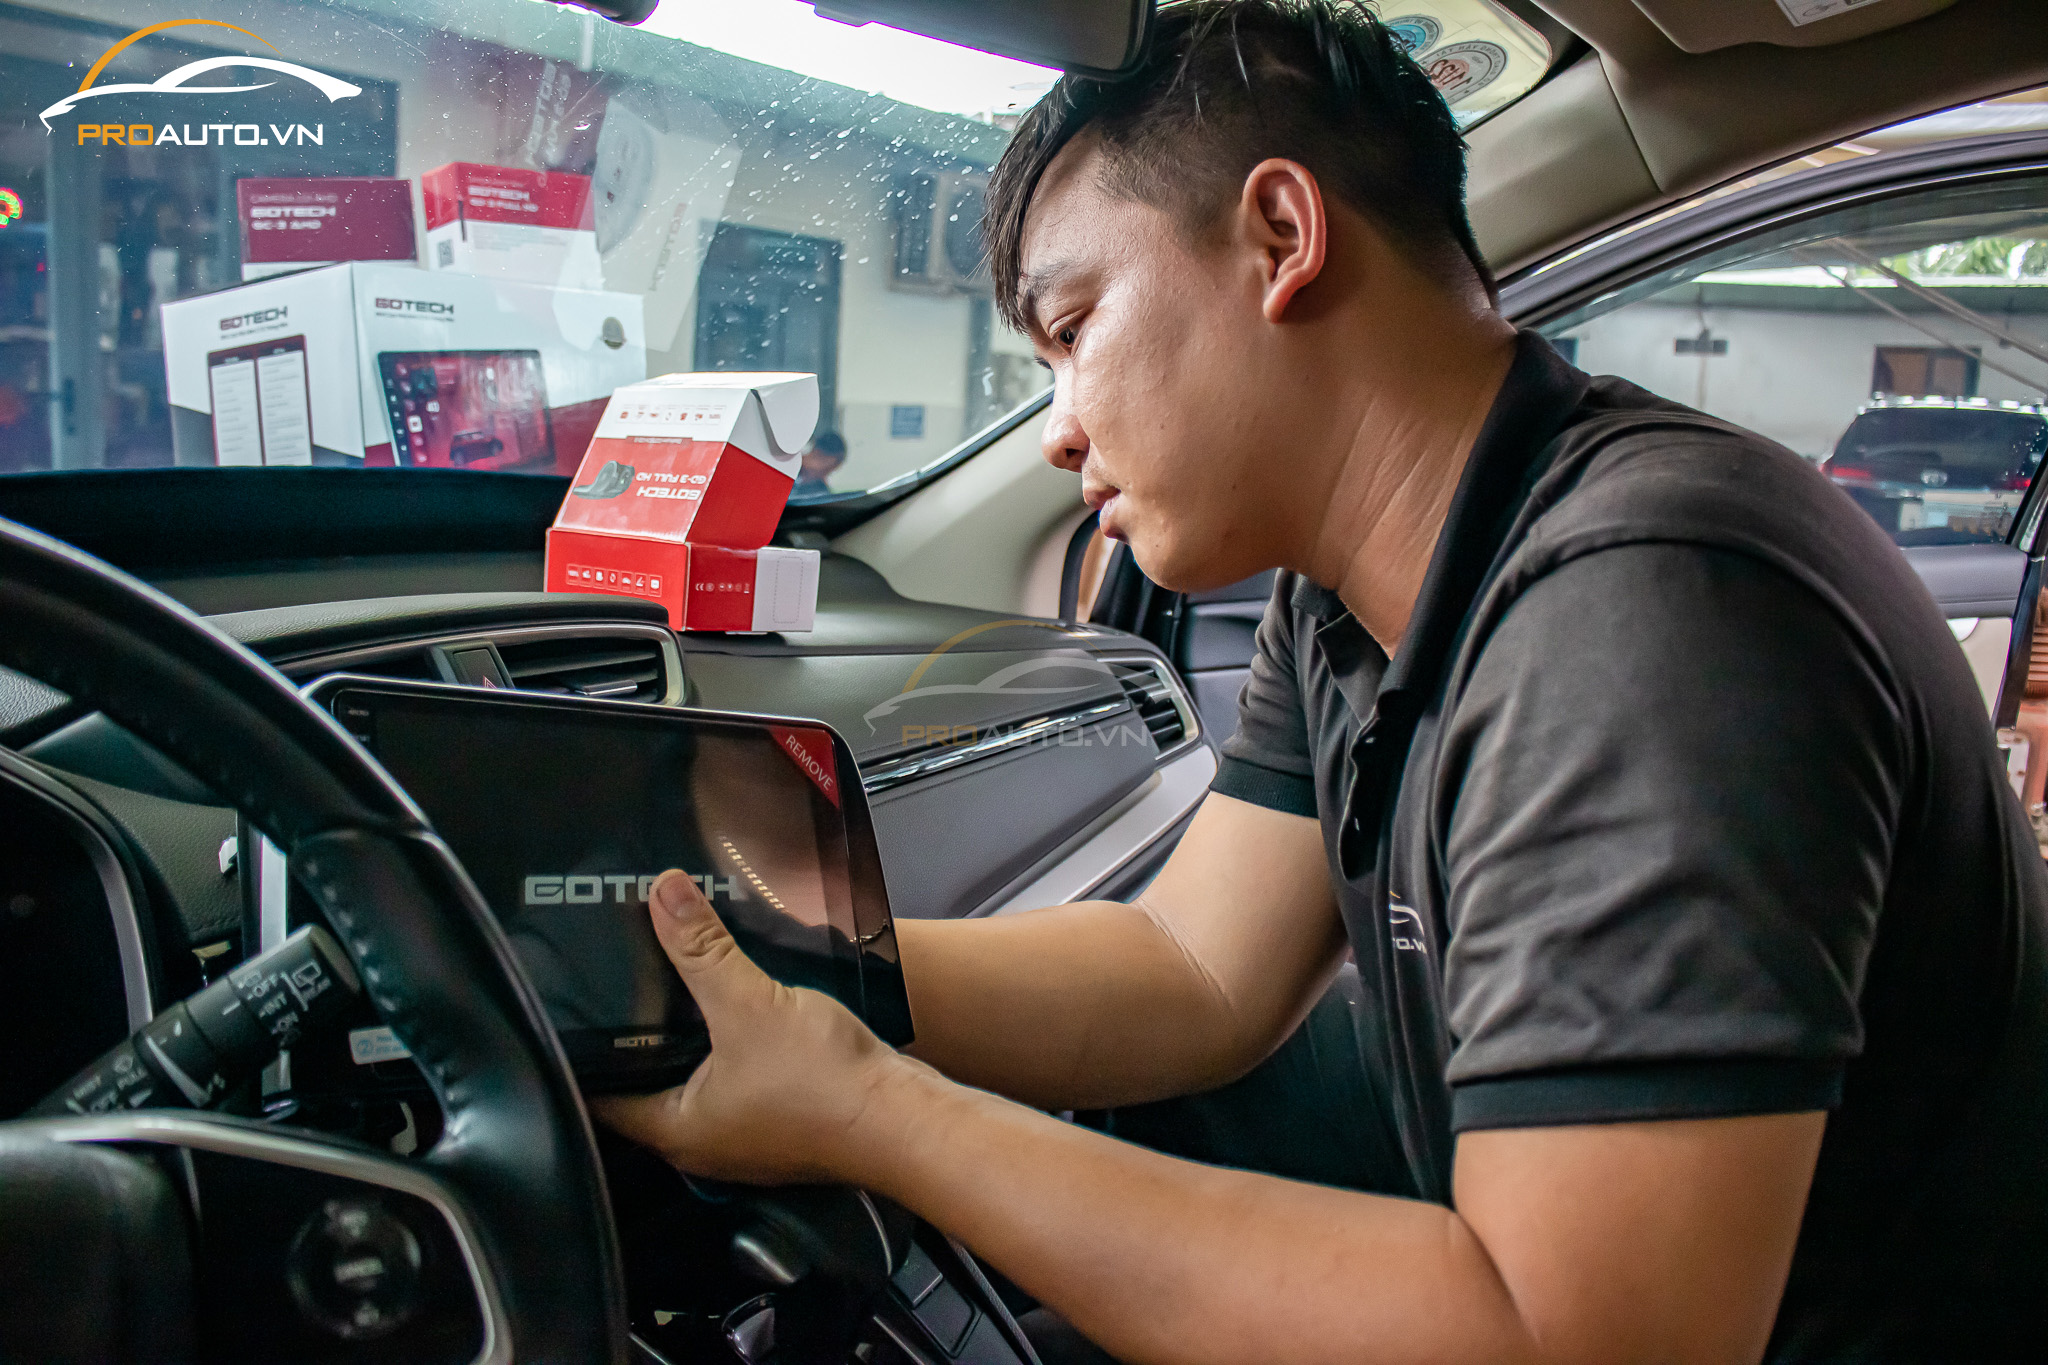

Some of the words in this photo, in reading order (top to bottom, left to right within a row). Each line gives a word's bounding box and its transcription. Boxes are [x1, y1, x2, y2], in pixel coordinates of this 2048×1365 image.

[375, 298, 455, 315] GOTECH
[219, 306, 289, 331] GOTECH
[636, 486, 702, 500] GOTECH
[786, 735, 834, 791] REMOVE
